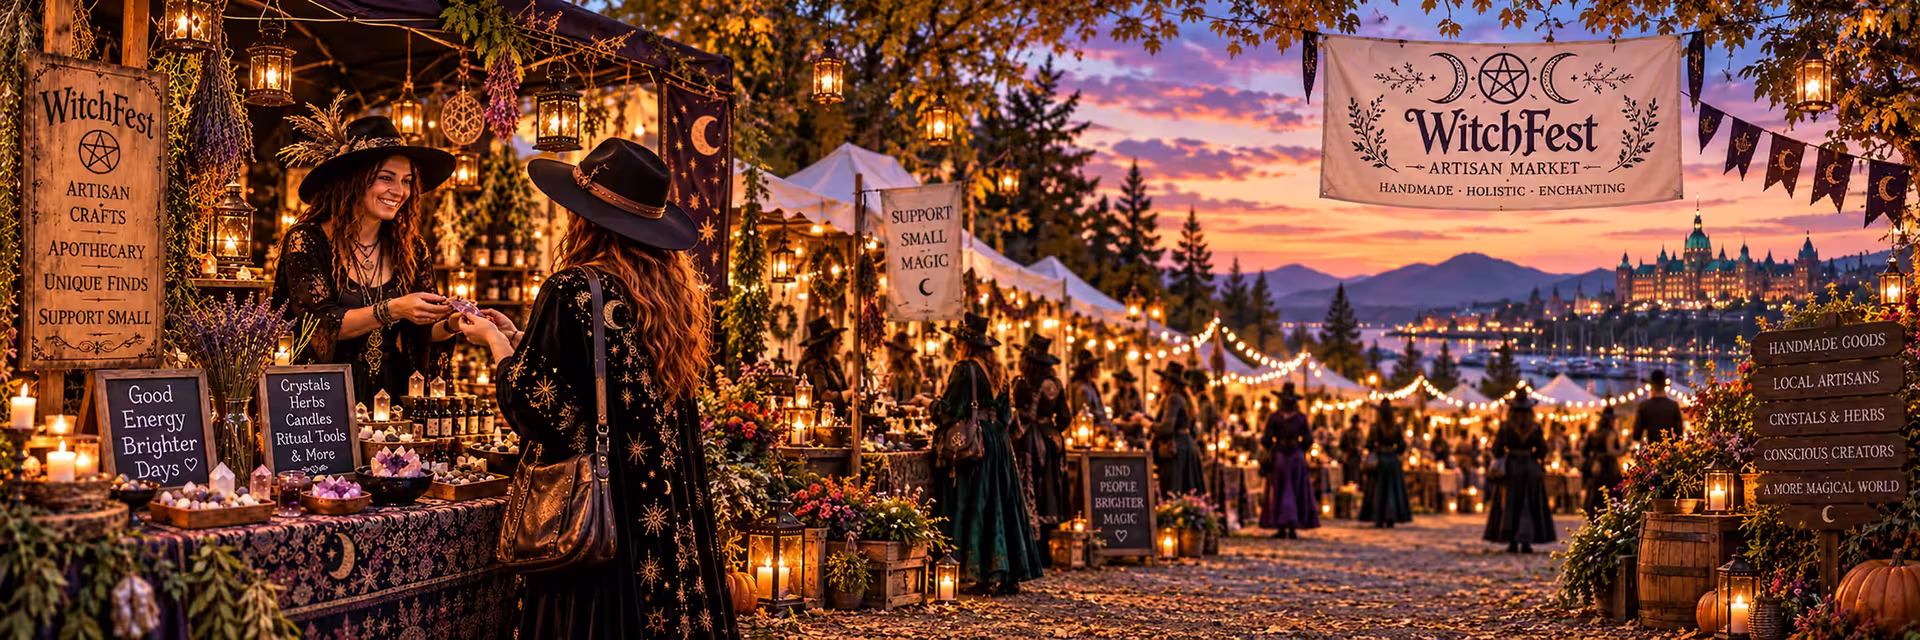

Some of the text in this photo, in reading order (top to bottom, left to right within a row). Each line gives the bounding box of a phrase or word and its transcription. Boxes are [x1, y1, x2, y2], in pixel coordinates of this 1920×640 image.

[39, 86, 155, 140] WitchFest
[1405, 108, 1599, 157] WitchFest
[1429, 162, 1580, 175] ARTISAN MARKET
[66, 180, 130, 200] ARTISAN
[1379, 182, 1625, 197] HANDMADE HOLISTIC ENCHANTING
[70, 207, 126, 225] CRAFTS
[892, 206, 952, 224] SUPPORT
[901, 230, 947, 247] SMALL
[48, 239, 146, 259] APOTHECARY
[901, 254, 948, 270] MAGIC
[44, 273, 148, 292] UNIQUE FINDS
[39, 308, 151, 325] SUPPORT SMALL
[1769, 333, 1885, 355] HANDMADE GOODS
[281, 378, 330, 395] Crystals
[1774, 371, 1880, 390] LOCAL ARTISANS
[129, 385, 173, 404] Good
[290, 396, 325, 409] Herbs
[122, 410, 185, 432] Energy
[286, 414, 332, 427] Candles
[1770, 408, 1885, 426] CRYSTALS & HERBS
[275, 429, 346, 446] Ritual Tools
[121, 435, 197, 459] Brighter
[291, 448, 335, 462] & More
[1764, 445, 1895, 461] CONSCIOUS CREATORS
[134, 460, 180, 483] Days
[1105, 465, 1130, 477] KIND
[1100, 481, 1137, 492] PEOPLE
[1764, 480, 1899, 495] A MORE MAGICAL WORLD
[1095, 498, 1144, 508] BRIGHTER
[1103, 514, 1137, 524] MAGIC
